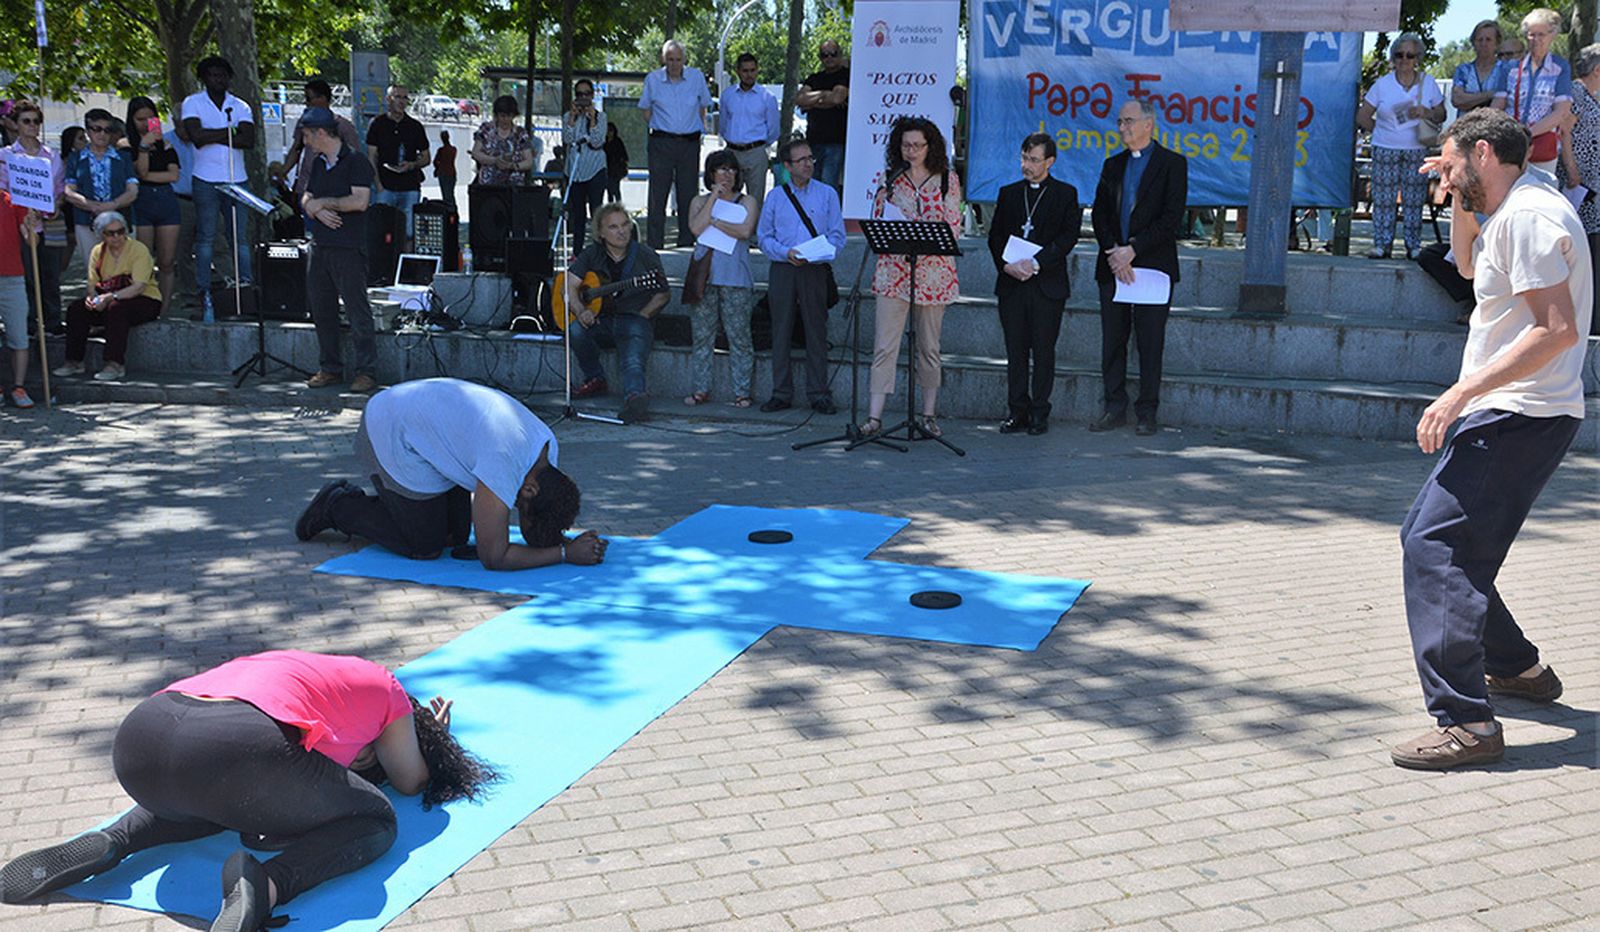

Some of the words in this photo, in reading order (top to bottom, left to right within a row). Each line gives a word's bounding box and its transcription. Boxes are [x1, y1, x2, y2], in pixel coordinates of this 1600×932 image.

[899, 36, 909, 45] de
[910, 36, 937, 45] Madrid
[881, 92, 918, 108] QUE
[1026, 72, 1113, 120] Papa
[1125, 74, 1314, 129] Franciso
[1231, 128, 1309, 167] 23
[16, 176, 29, 186] CON
